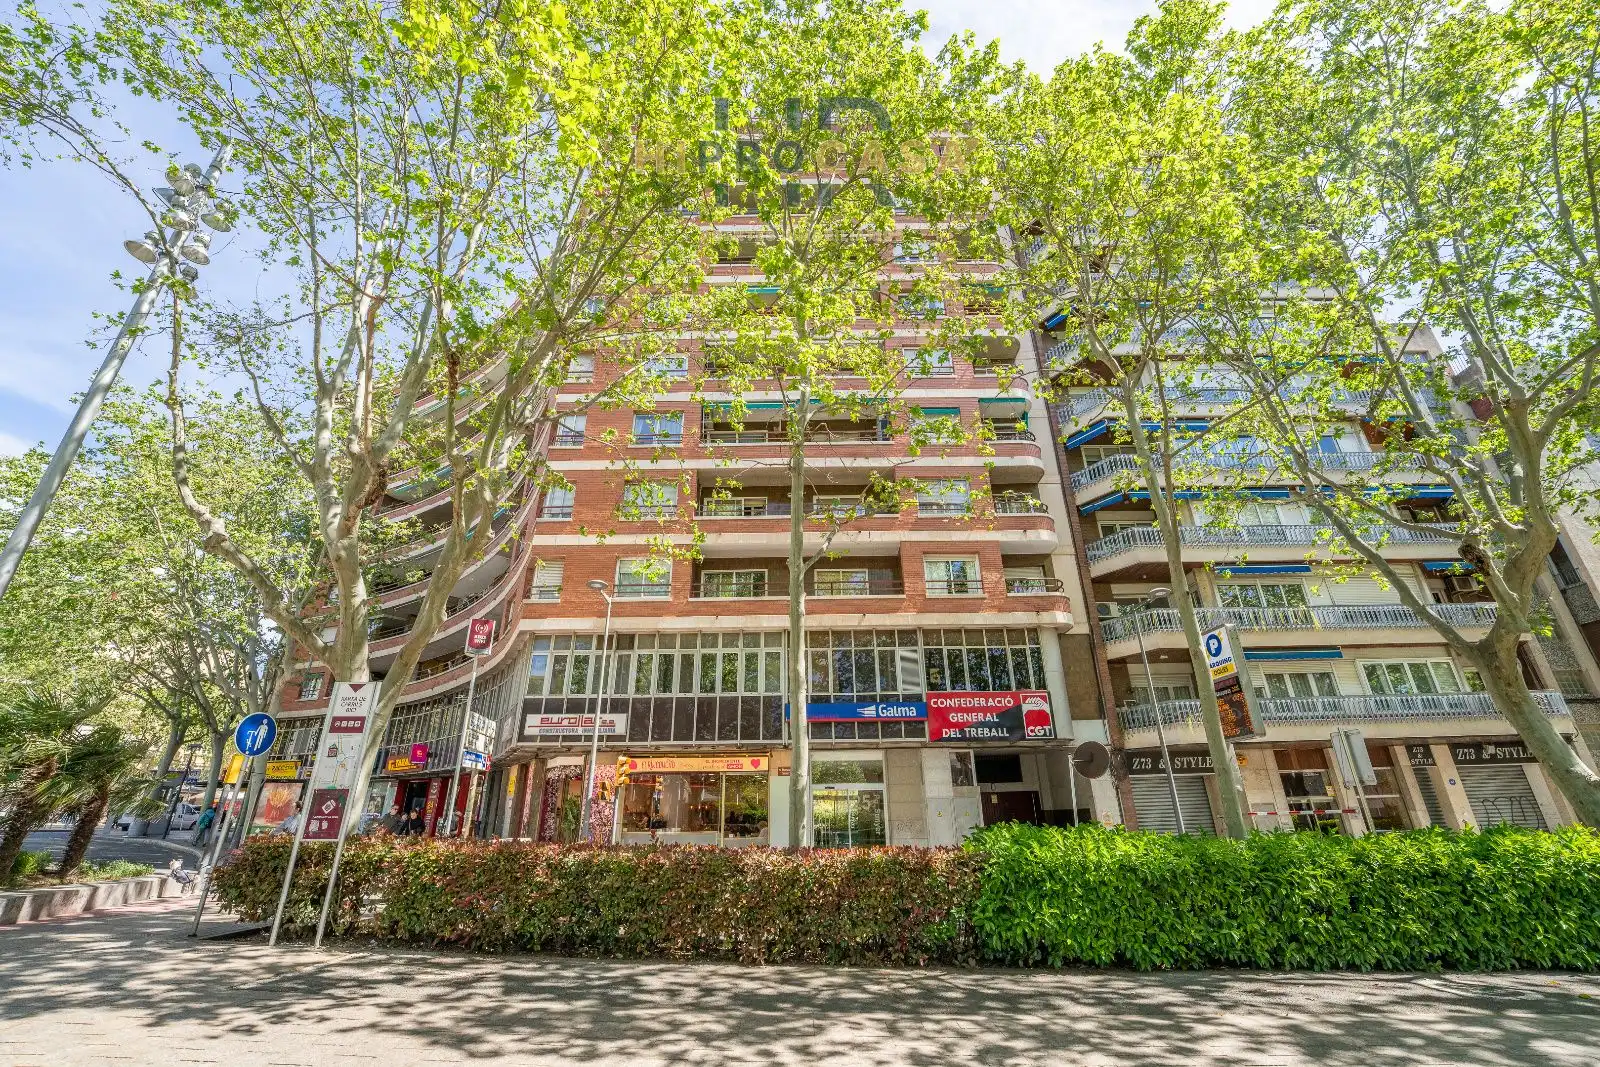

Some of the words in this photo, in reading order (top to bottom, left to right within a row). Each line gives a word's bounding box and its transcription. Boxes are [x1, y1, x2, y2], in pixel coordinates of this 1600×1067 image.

[930, 694, 1014, 708] CONFEDERACIÓ
[878, 703, 917, 717] Galma
[949, 712, 1000, 723] GENERAL
[942, 728, 962, 738] DEL
[963, 727, 1010, 738] TREBALL
[1027, 725, 1051, 737] CGT
[1456, 747, 1476, 760] Z73
[1132, 757, 1152, 770] Z73
[1174, 755, 1214, 769] STYLE
